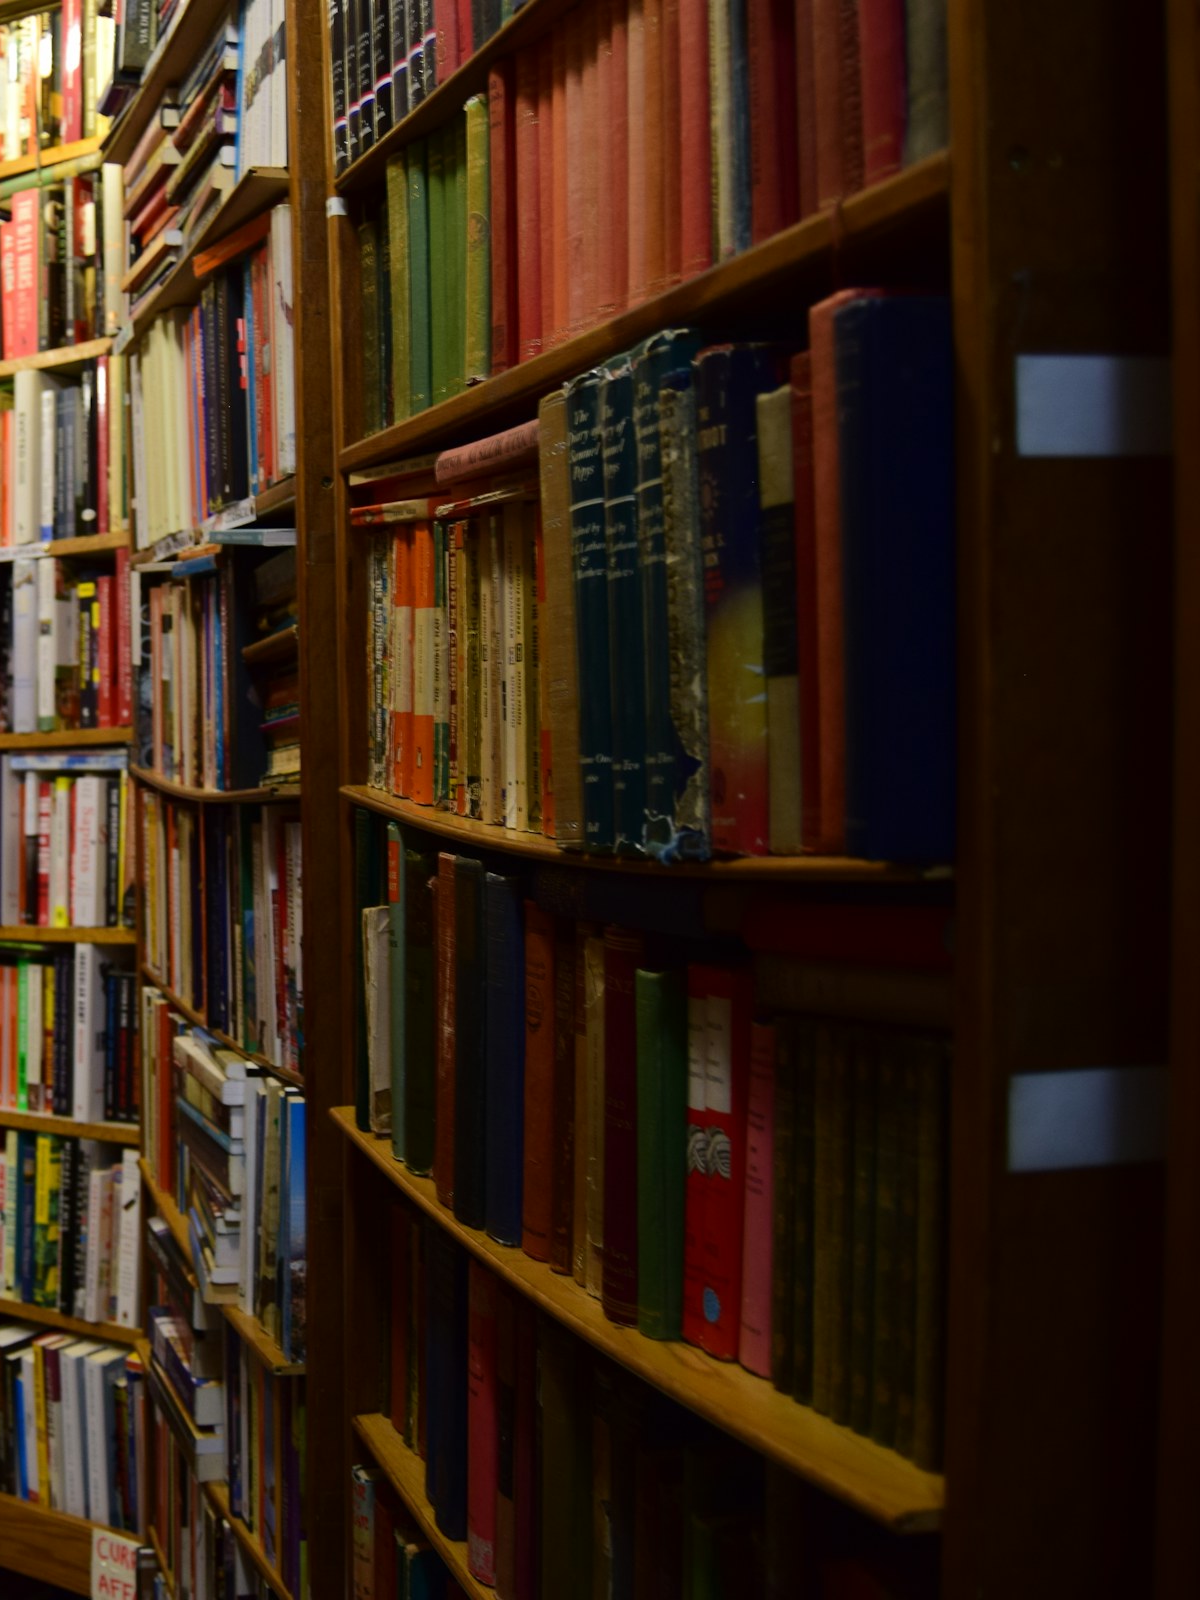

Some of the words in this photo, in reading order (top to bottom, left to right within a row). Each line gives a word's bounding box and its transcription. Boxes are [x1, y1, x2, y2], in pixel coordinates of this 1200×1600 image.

[449, 534, 457, 555] THE
[449, 557, 457, 587] MIND
[374, 580, 383, 600] THE
[449, 592, 457, 607] OF
[531, 625, 540, 669] CENTURY
[450, 704, 458, 744] Wallace
[78, 807, 93, 873] Sapiens
